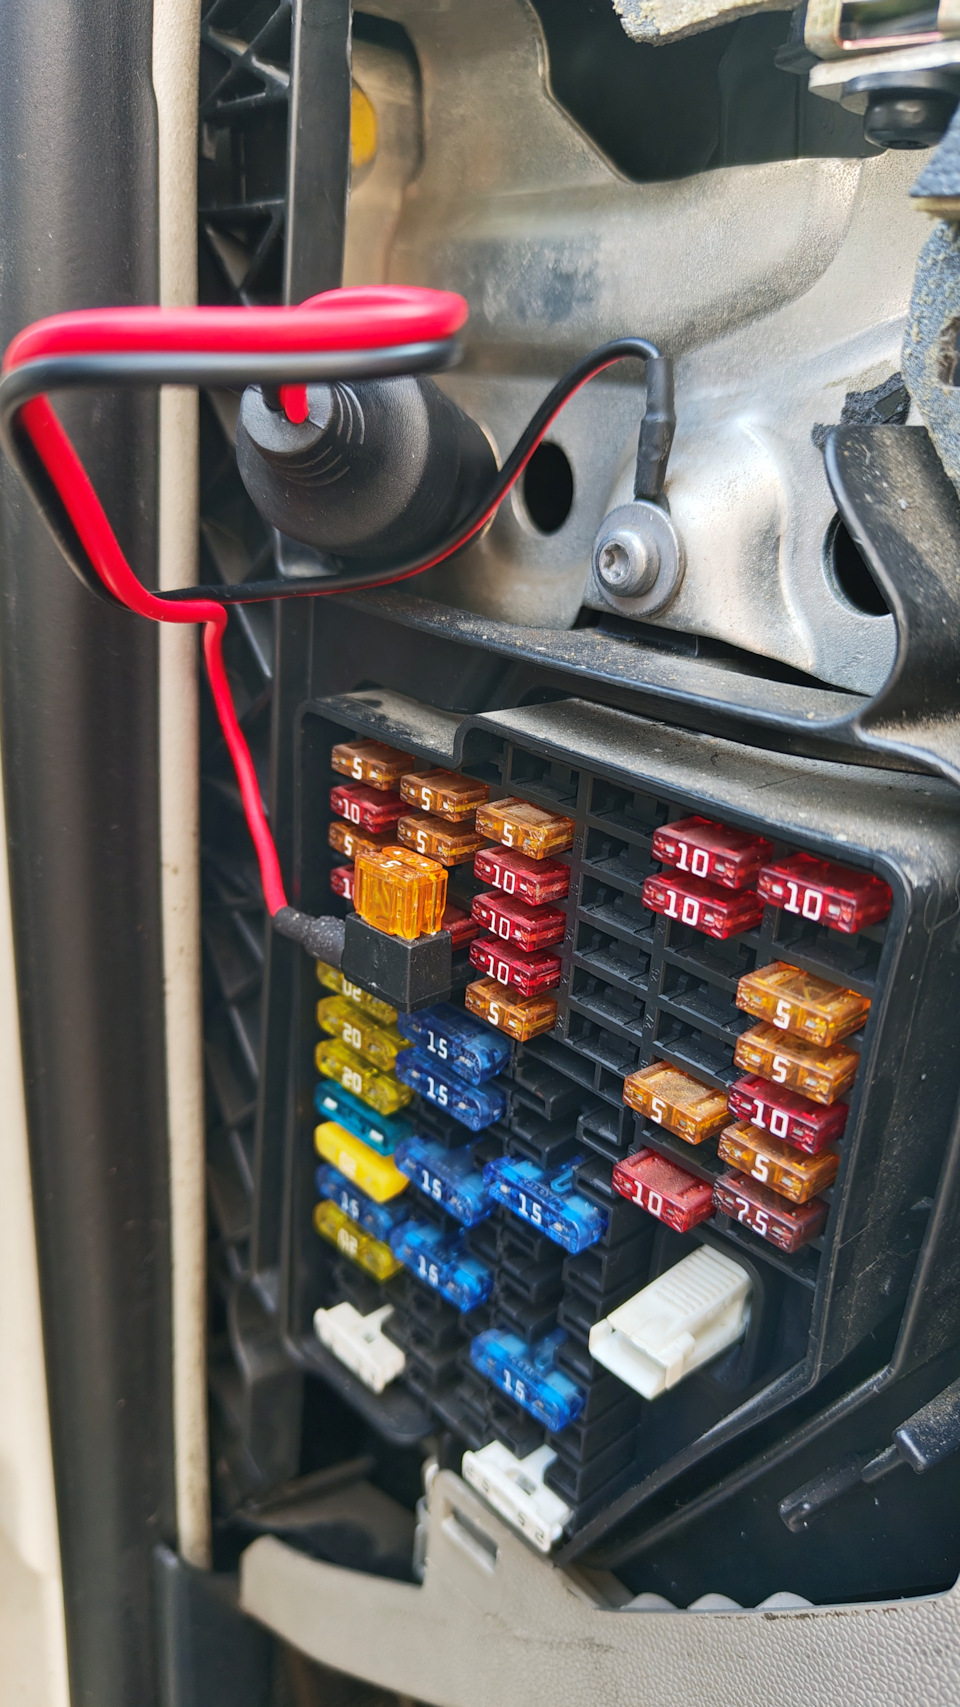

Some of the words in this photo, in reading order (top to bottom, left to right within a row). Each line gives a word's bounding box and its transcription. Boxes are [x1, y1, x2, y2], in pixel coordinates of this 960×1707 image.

[352, 757, 363, 780] 5
[342, 798, 361, 825] 10
[421, 787, 433, 811] 5
[344, 835, 354, 857] 5
[416, 830, 428, 854] 5
[501, 821, 514, 847] 5
[675, 842, 709, 878] 10
[491, 864, 515, 895] 10
[664, 890, 699, 926] 10
[784, 882, 823, 921] 10
[487, 908, 511, 940] 10
[486, 954, 509, 986] 10
[487, 1002, 499, 1026] 5
[773, 998, 791, 1029] 5
[342, 1022, 362, 1050] 20
[426, 1031, 448, 1060] 15
[341, 1065, 362, 1094] 20
[772, 1055, 791, 1083] 5
[426, 1076, 448, 1106] 15
[651, 1097, 666, 1124] 5
[751, 1099, 788, 1139] 10
[751, 1154, 769, 1183] 5
[421, 1169, 442, 1200] 15
[632, 1180, 662, 1217] 10
[518, 1192, 542, 1225] 15
[736, 1197, 768, 1236] 7.5
[418, 1254, 439, 1287] 15
[502, 1369, 525, 1403] 15
